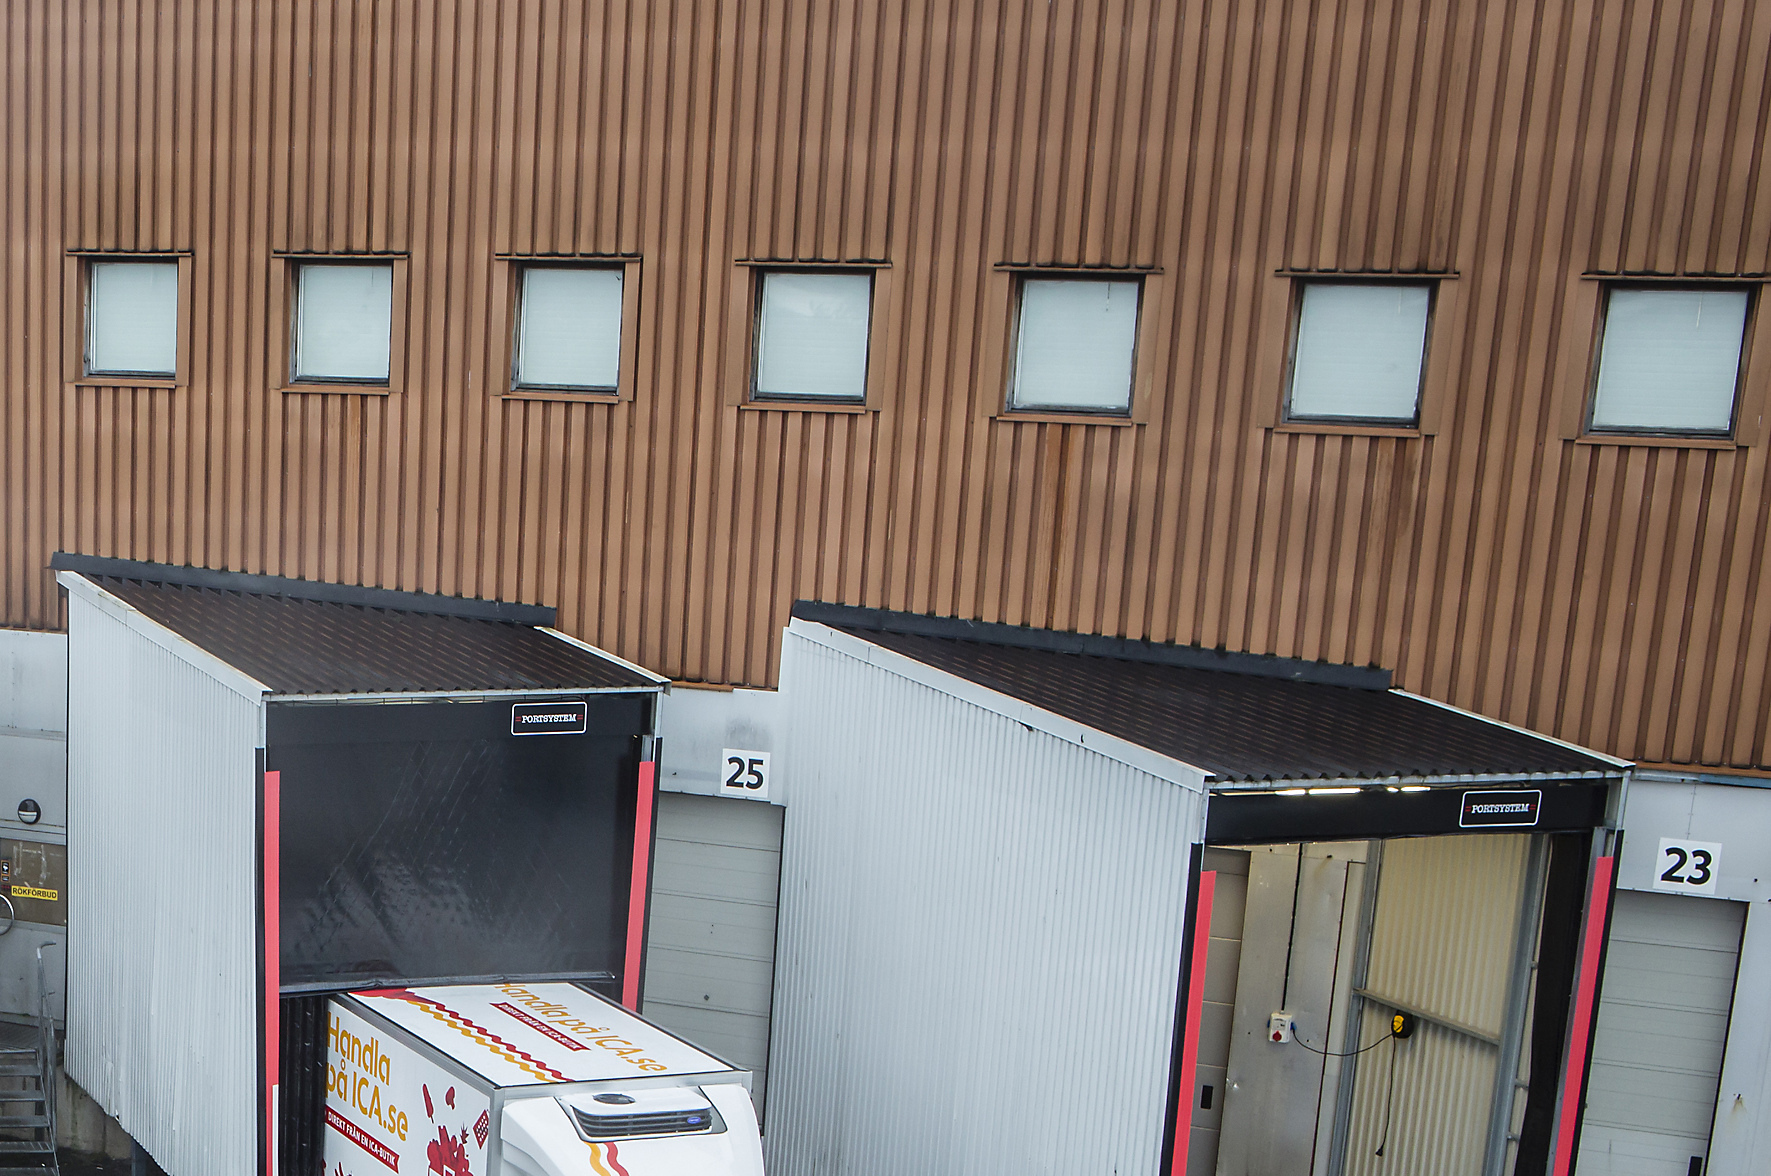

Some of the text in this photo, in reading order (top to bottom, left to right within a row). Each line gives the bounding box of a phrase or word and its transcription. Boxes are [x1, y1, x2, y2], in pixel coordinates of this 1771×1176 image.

[521, 714, 577, 724] PORTSYSTEM
[726, 756, 764, 790] 25
[1471, 803, 1530, 814] PORTSYSTEM
[1660, 846, 1712, 886] 23
[328, 1011, 391, 1086] Handla
[547, 1018, 610, 1034] på
[586, 1035, 668, 1071] ICA.se
[325, 1058, 408, 1142] på ICA.se
[328, 1112, 347, 1131] DIREKT
[361, 1134, 369, 1147] EN
[368, 1139, 395, 1166] ICA-BUTIK
